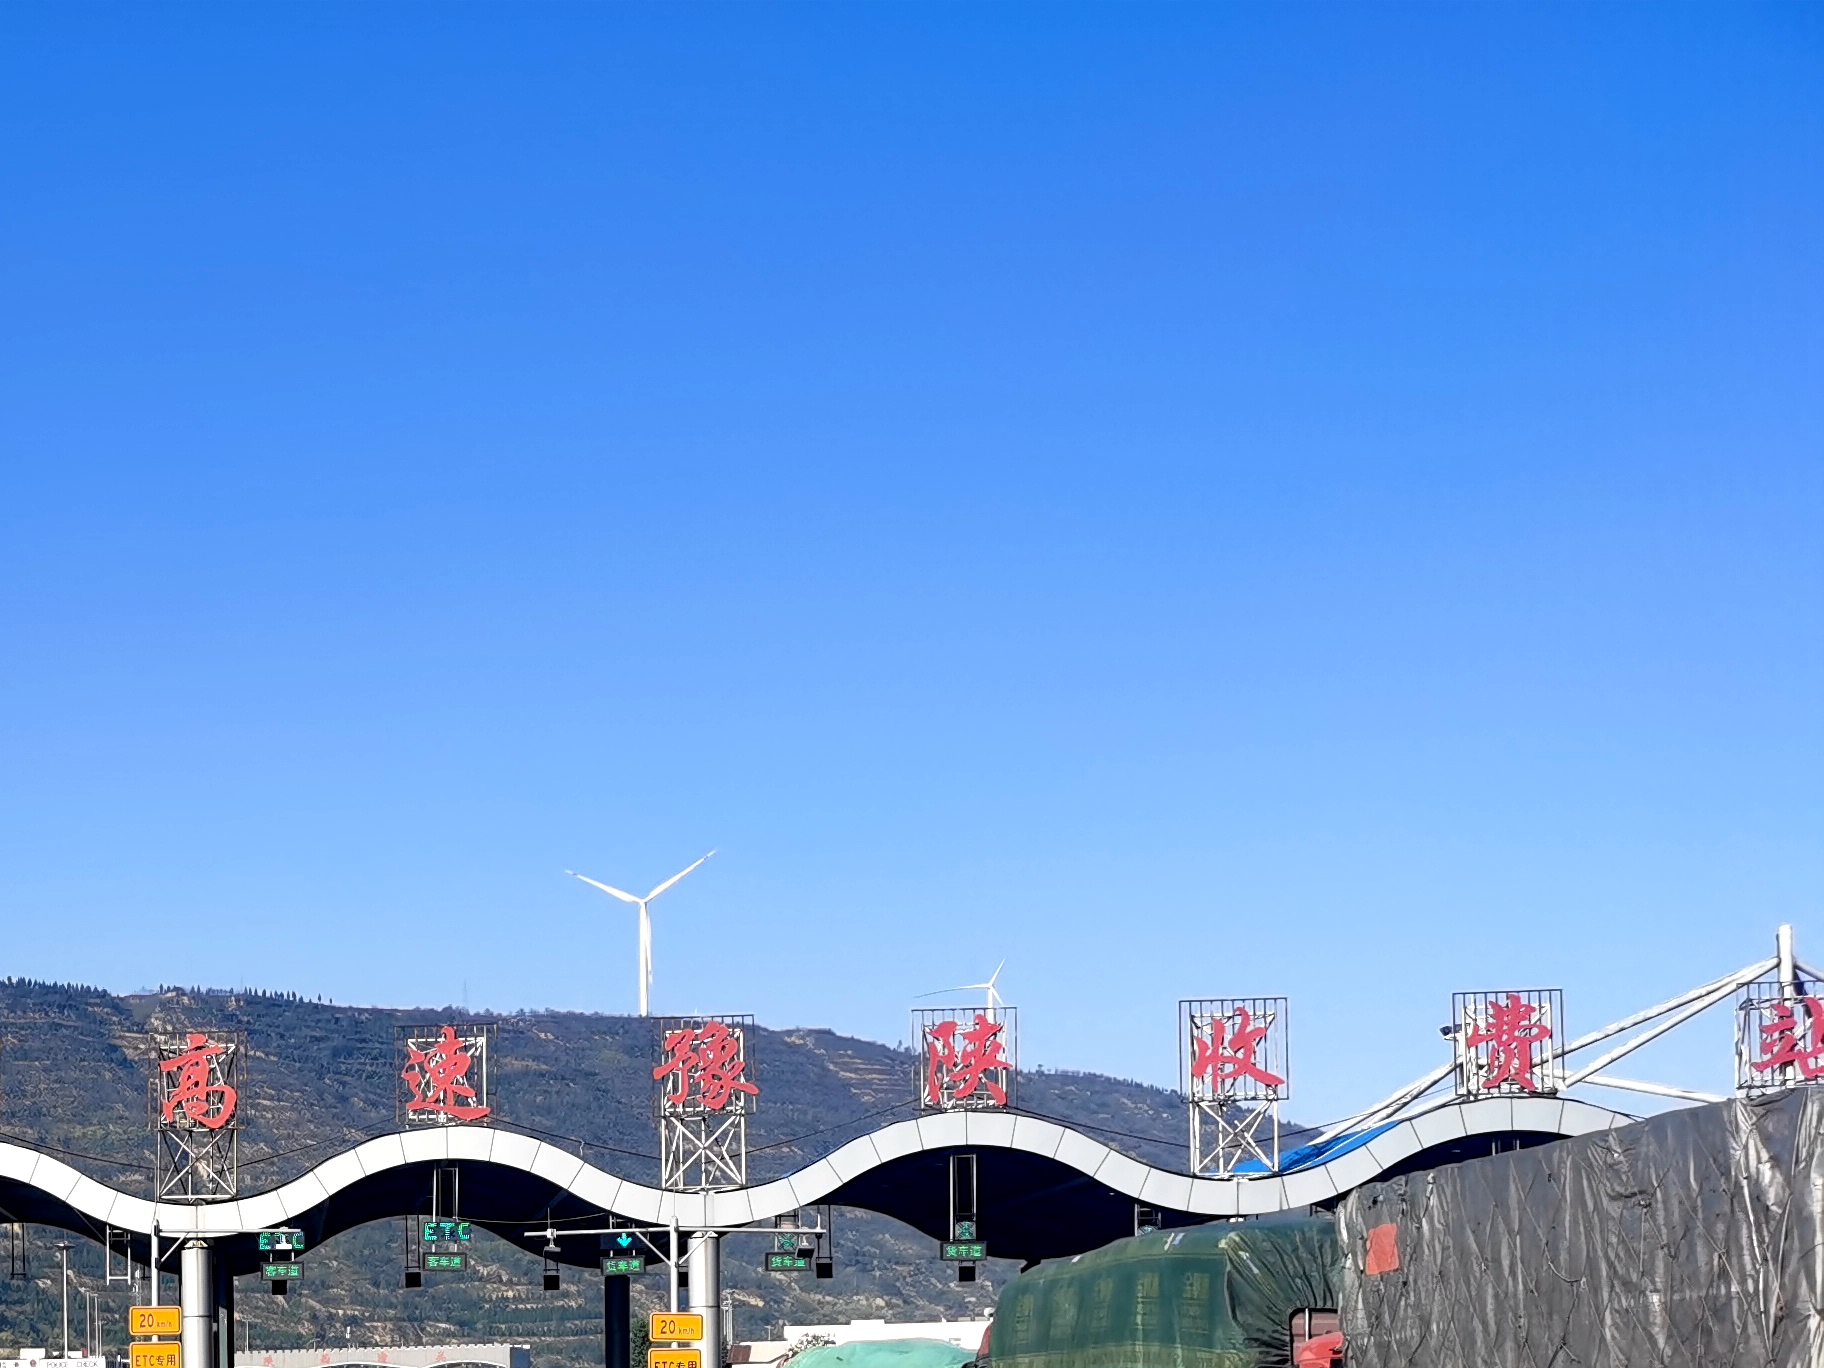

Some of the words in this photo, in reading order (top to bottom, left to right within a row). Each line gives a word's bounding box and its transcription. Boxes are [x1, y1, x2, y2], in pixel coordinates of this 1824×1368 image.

[424, 1222, 471, 1241] ETC
[139, 1313, 155, 1329] 20
[156, 1321, 173, 1329] km/h
[660, 1319, 676, 1335] 20
[678, 1327, 695, 1335] km/h
